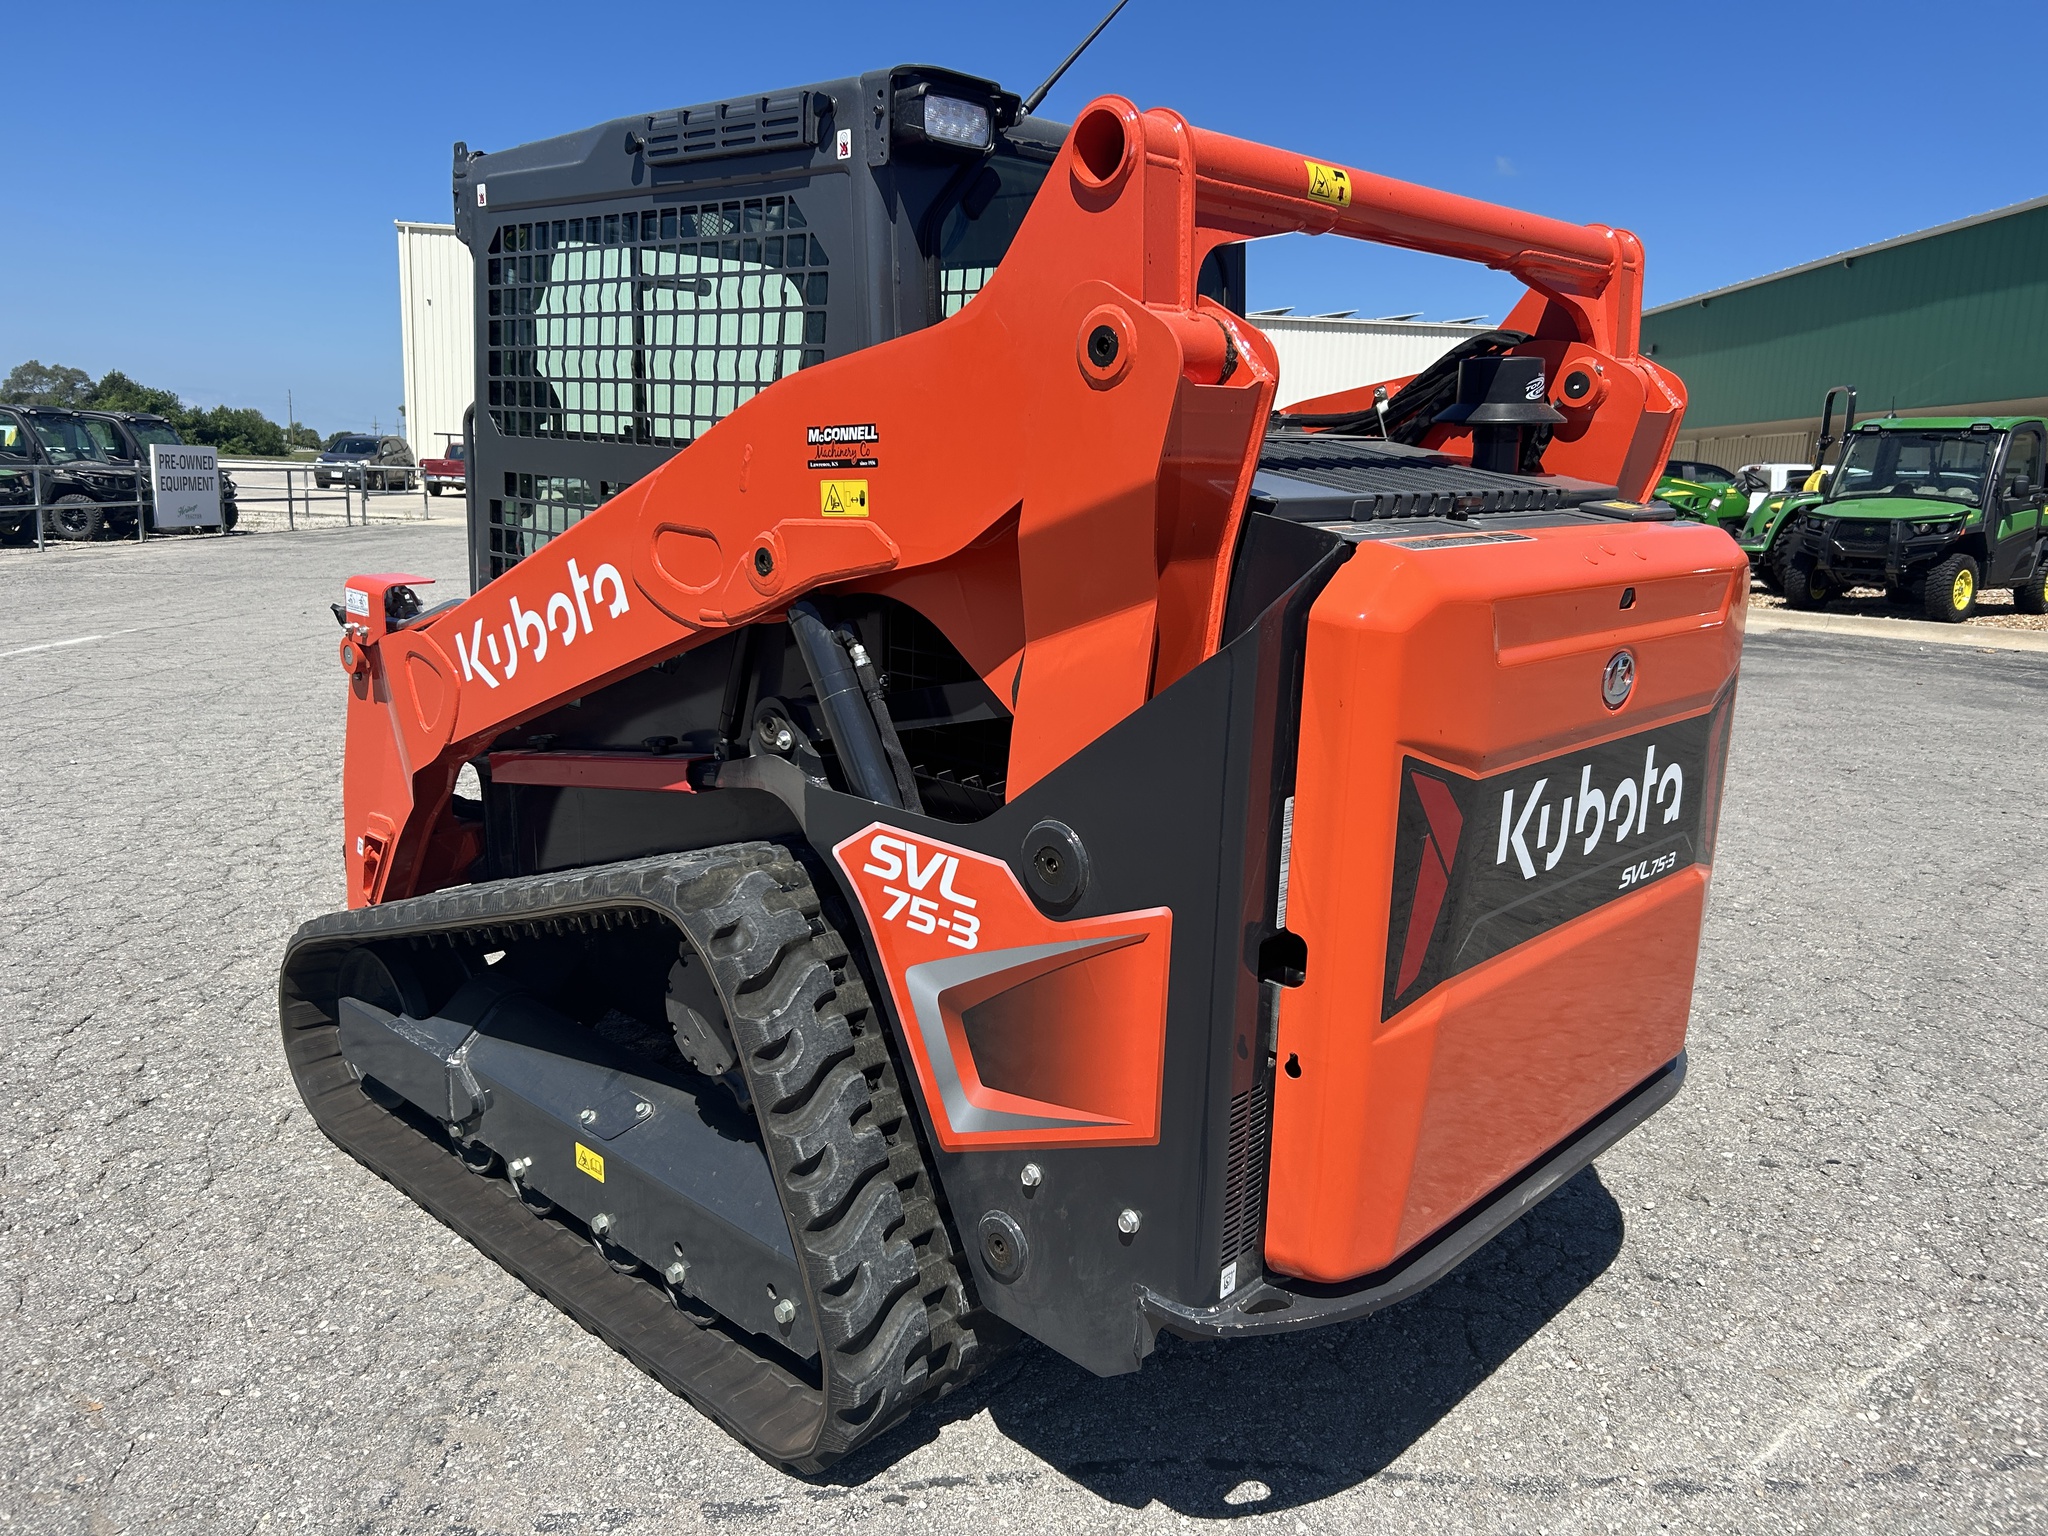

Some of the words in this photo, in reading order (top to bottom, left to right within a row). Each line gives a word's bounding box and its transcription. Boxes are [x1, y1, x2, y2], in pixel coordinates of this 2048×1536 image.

[808, 425, 878, 443] McCONNELL
[815, 441, 857, 465] Machinery
[860, 441, 871, 457] Co
[158, 453, 214, 470] PRE-OWNED
[160, 475, 214, 492] EQUIPMENT
[455, 558, 630, 689] Kubota
[1496, 745, 1683, 880] Kubota
[863, 834, 977, 909] SVL
[882, 885, 980, 950] 75-3
